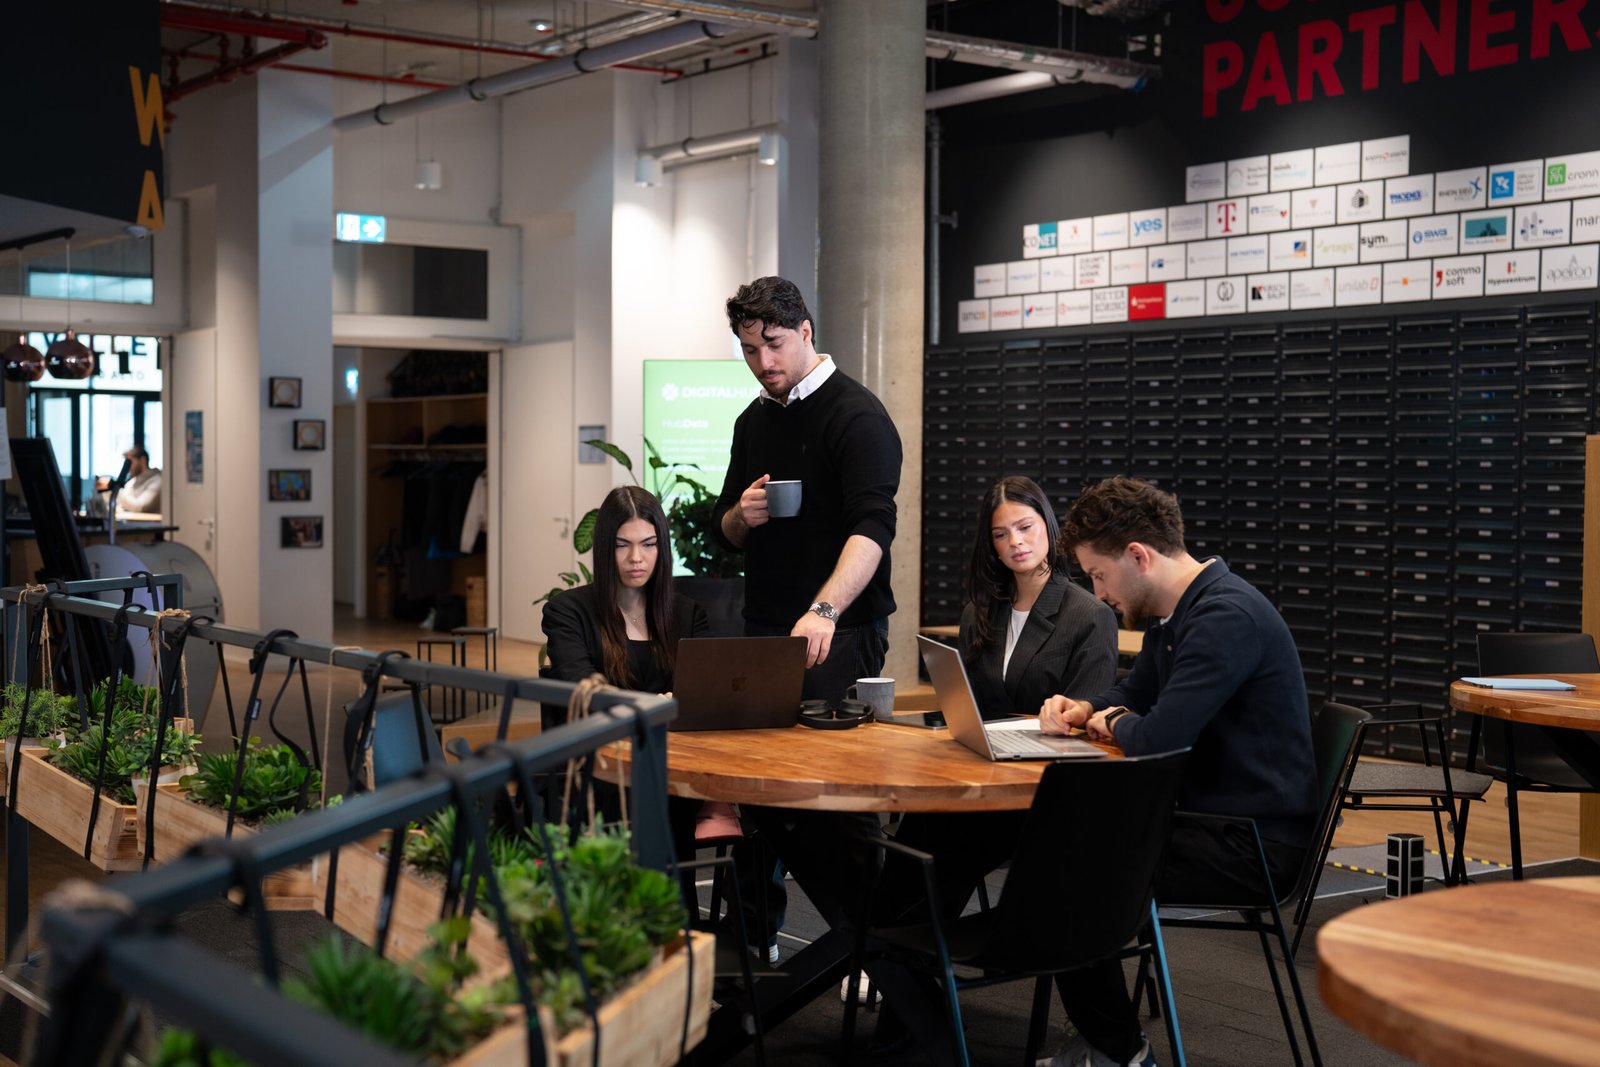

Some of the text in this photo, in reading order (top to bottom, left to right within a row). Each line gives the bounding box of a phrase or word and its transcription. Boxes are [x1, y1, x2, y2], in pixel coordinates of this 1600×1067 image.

[1202, 0, 1600, 119] PARTNER
[1133, 217, 1162, 237] yes
[1446, 265, 1481, 276] comma
[1446, 275, 1465, 287] soft
[1488, 275, 1536, 287] Hypozentrum
